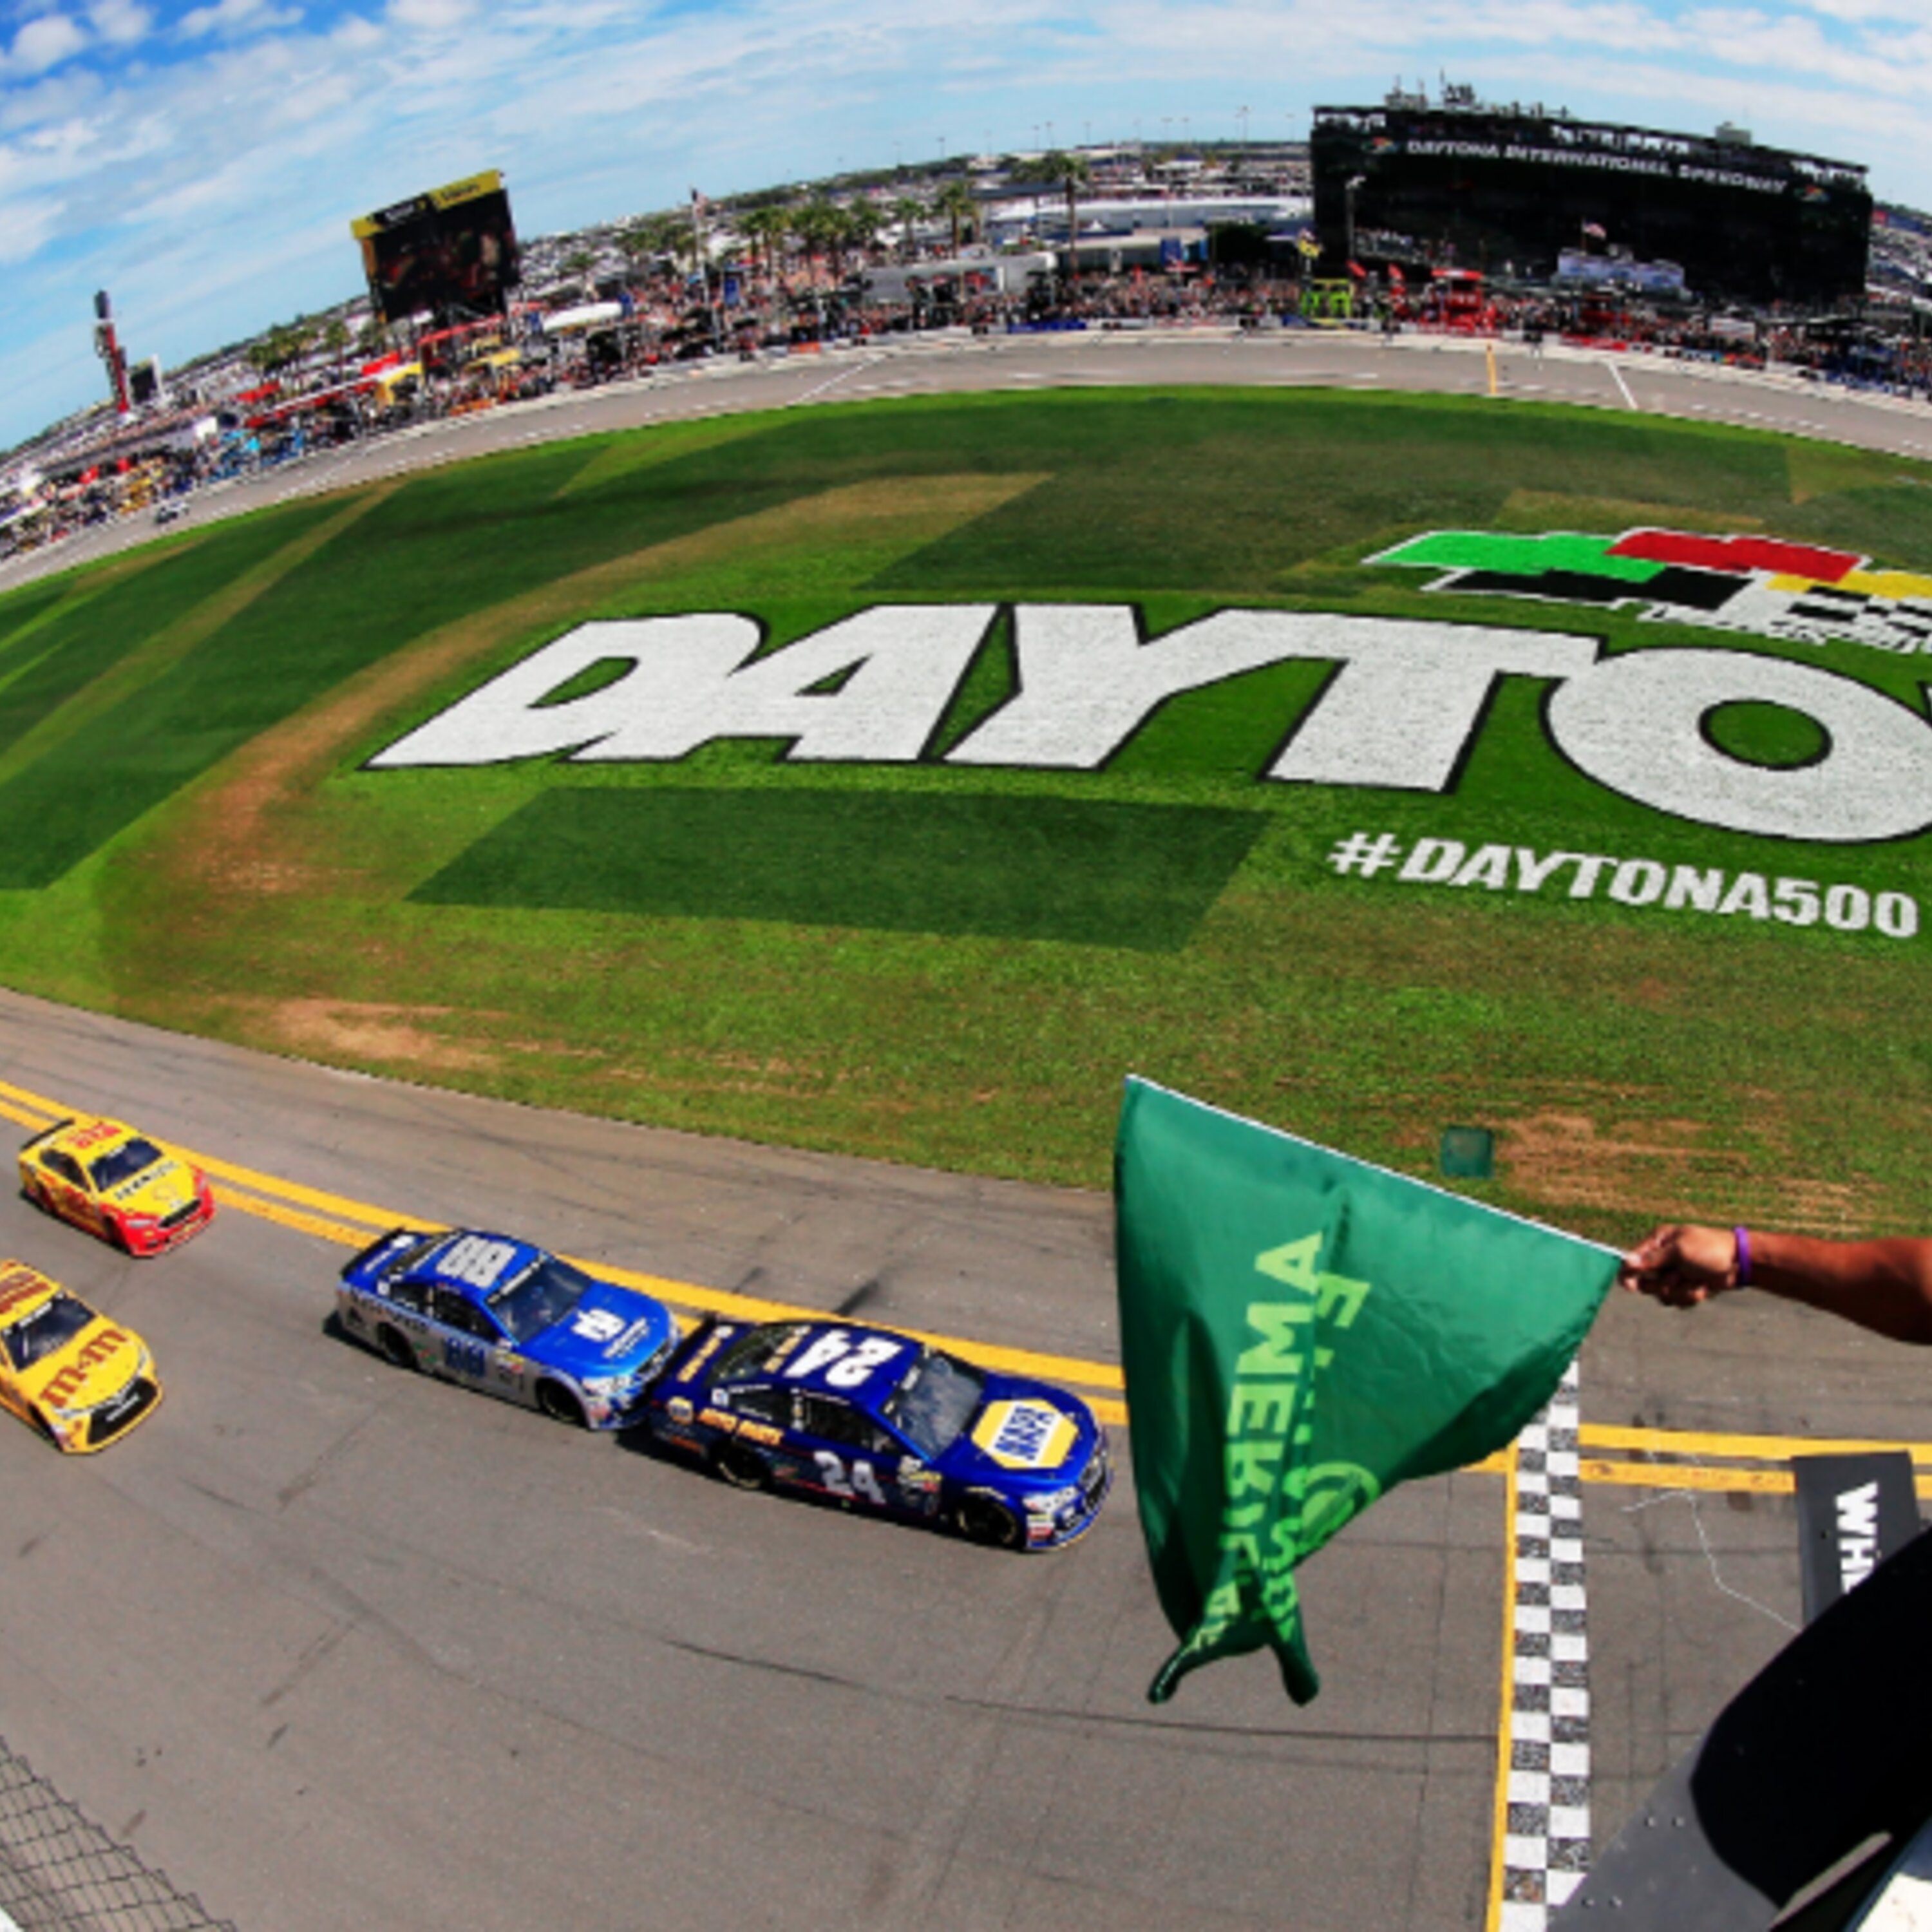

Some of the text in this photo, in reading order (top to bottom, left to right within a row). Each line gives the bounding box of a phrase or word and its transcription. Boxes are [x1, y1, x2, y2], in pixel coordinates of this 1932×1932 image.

[1407, 139, 1789, 194] DAYTONA INTERNATIONAL SPEEDWAY
[367, 602, 1932, 842] DAYTO
[1327, 831, 1919, 938] #DAYTONA500
[783, 1329, 903, 1387] 24
[813, 1451, 886, 1505] 24
